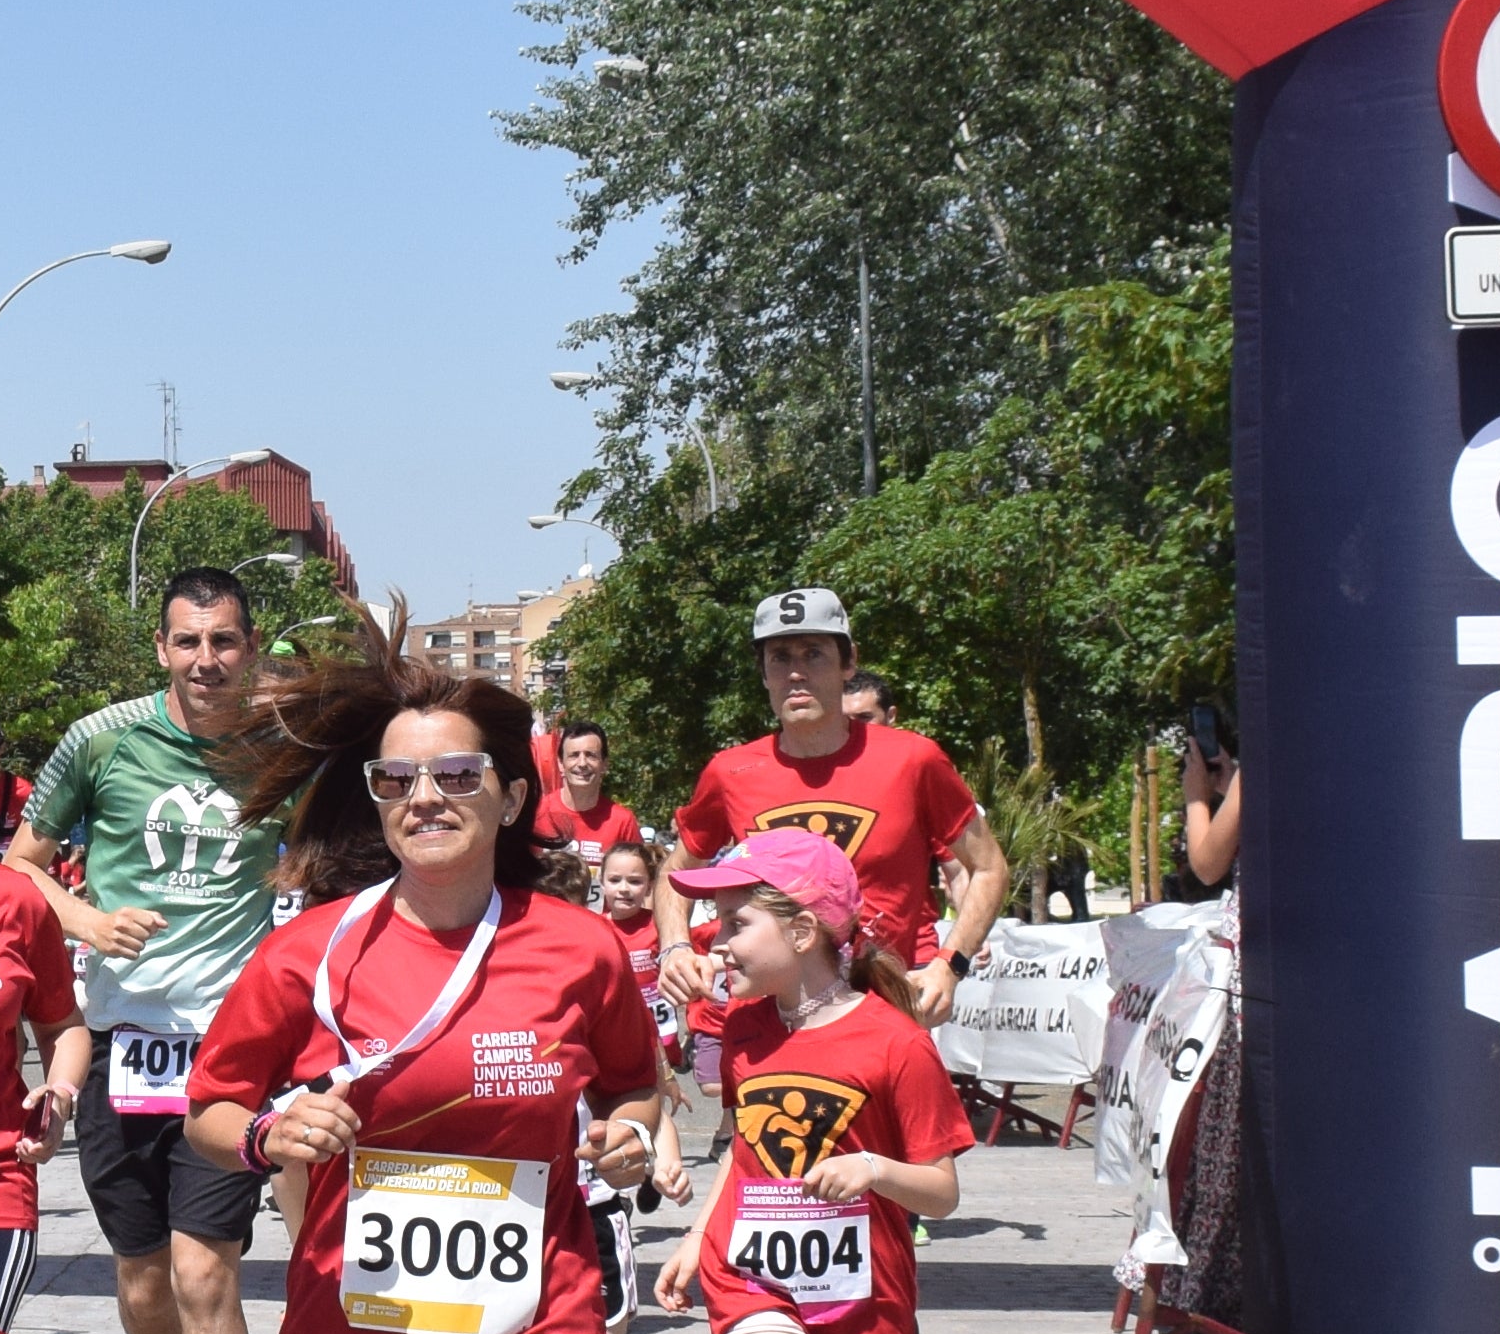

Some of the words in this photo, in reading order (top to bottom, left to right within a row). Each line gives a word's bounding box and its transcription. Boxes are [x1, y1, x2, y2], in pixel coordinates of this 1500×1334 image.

[779, 593, 806, 624] S
[168, 871, 209, 886] 2017
[1060, 956, 1081, 980] LA
[1047, 1008, 1066, 1033] LA
[471, 1030, 537, 1048] CARRERA
[473, 1047, 533, 1064] CAMPUS
[474, 1061, 563, 1081] UNIVERSIDAD
[474, 1082, 493, 1098] DE
[496, 1081, 516, 1097] LA
[519, 1079, 555, 1096] RIOJA
[366, 1159, 416, 1175] CARRERA
[418, 1164, 468, 1179] CAMPUS
[363, 1172, 437, 1191] UNIVERSIDAD
[438, 1179, 455, 1193] DE
[455, 1181, 470, 1194] LA
[473, 1182, 502, 1196] RIOJA
[743, 1185, 779, 1195] CARRERA
[743, 1196, 801, 1205] UNIVERSIDAD
[358, 1212, 528, 1283] 3008
[735, 1226, 863, 1280] 4004
